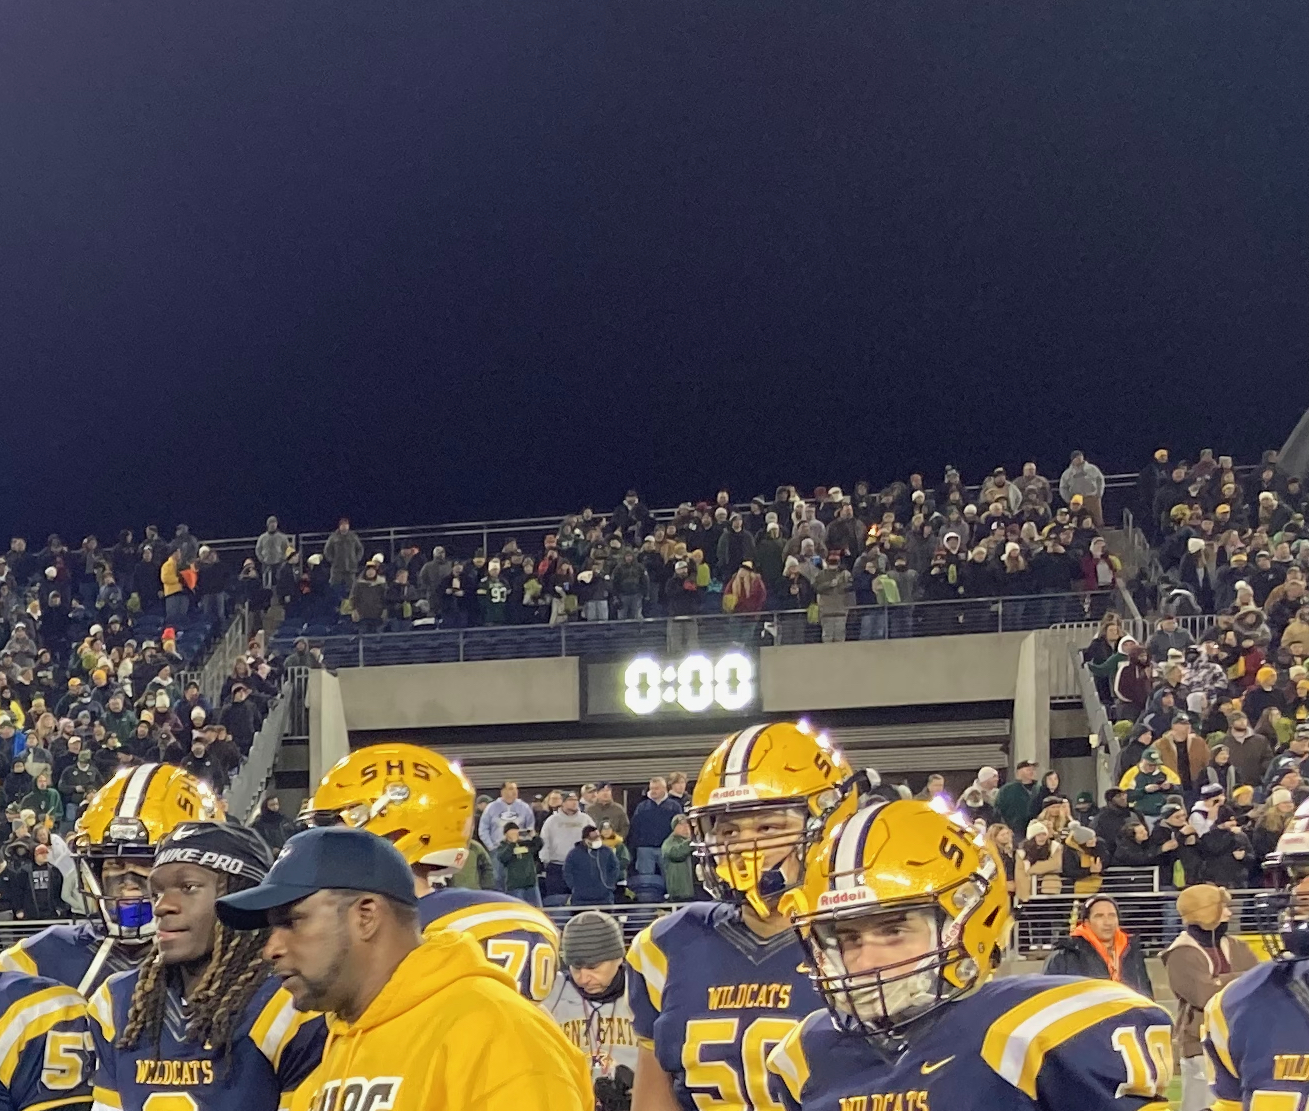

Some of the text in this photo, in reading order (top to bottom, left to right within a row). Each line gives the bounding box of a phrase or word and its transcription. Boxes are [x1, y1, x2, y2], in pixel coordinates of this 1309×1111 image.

[624, 652, 754, 716] 0:00
[360, 759, 432, 787] SHS
[200, 851, 244, 874] PRO
[821, 890, 866, 907] Riddell
[487, 938, 557, 1001] 70
[707, 983, 792, 1010] WILDCATS
[598, 1017, 639, 1047] STAT
[135, 1059, 214, 1085] WILDCATS
